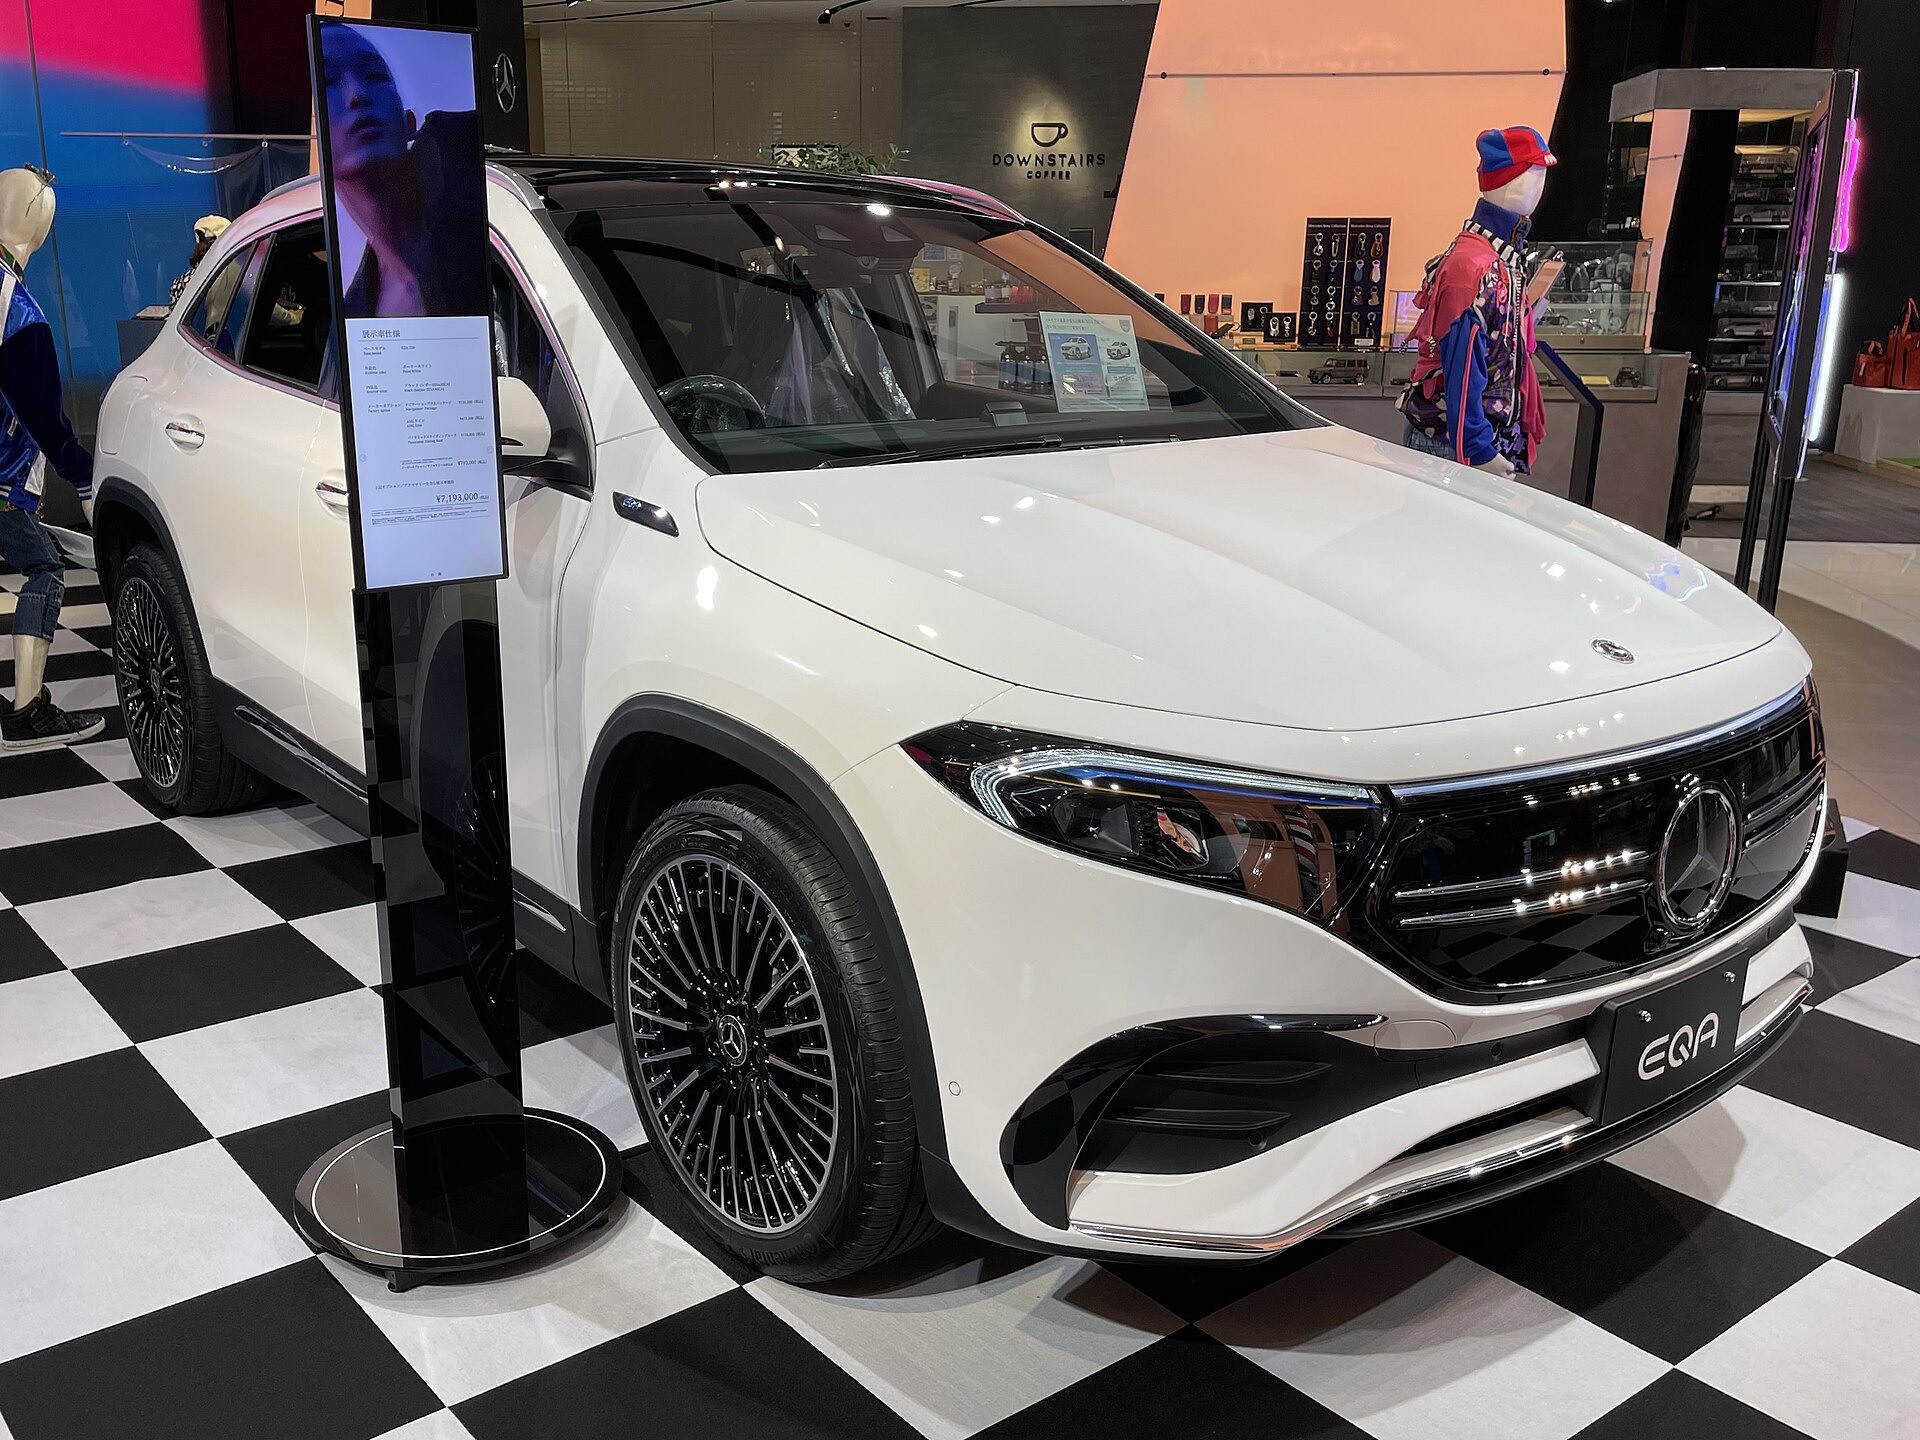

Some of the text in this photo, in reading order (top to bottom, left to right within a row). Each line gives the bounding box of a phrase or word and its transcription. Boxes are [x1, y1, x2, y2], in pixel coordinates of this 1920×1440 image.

[992, 153, 1105, 167] DOWNSTAIRS
[1026, 170, 1071, 180] COFFEE
[362, 329, 401, 339] 展示車仕様
[436, 492, 479, 504] ¥7,193,000
[1637, 1012, 1720, 1081] EQA
